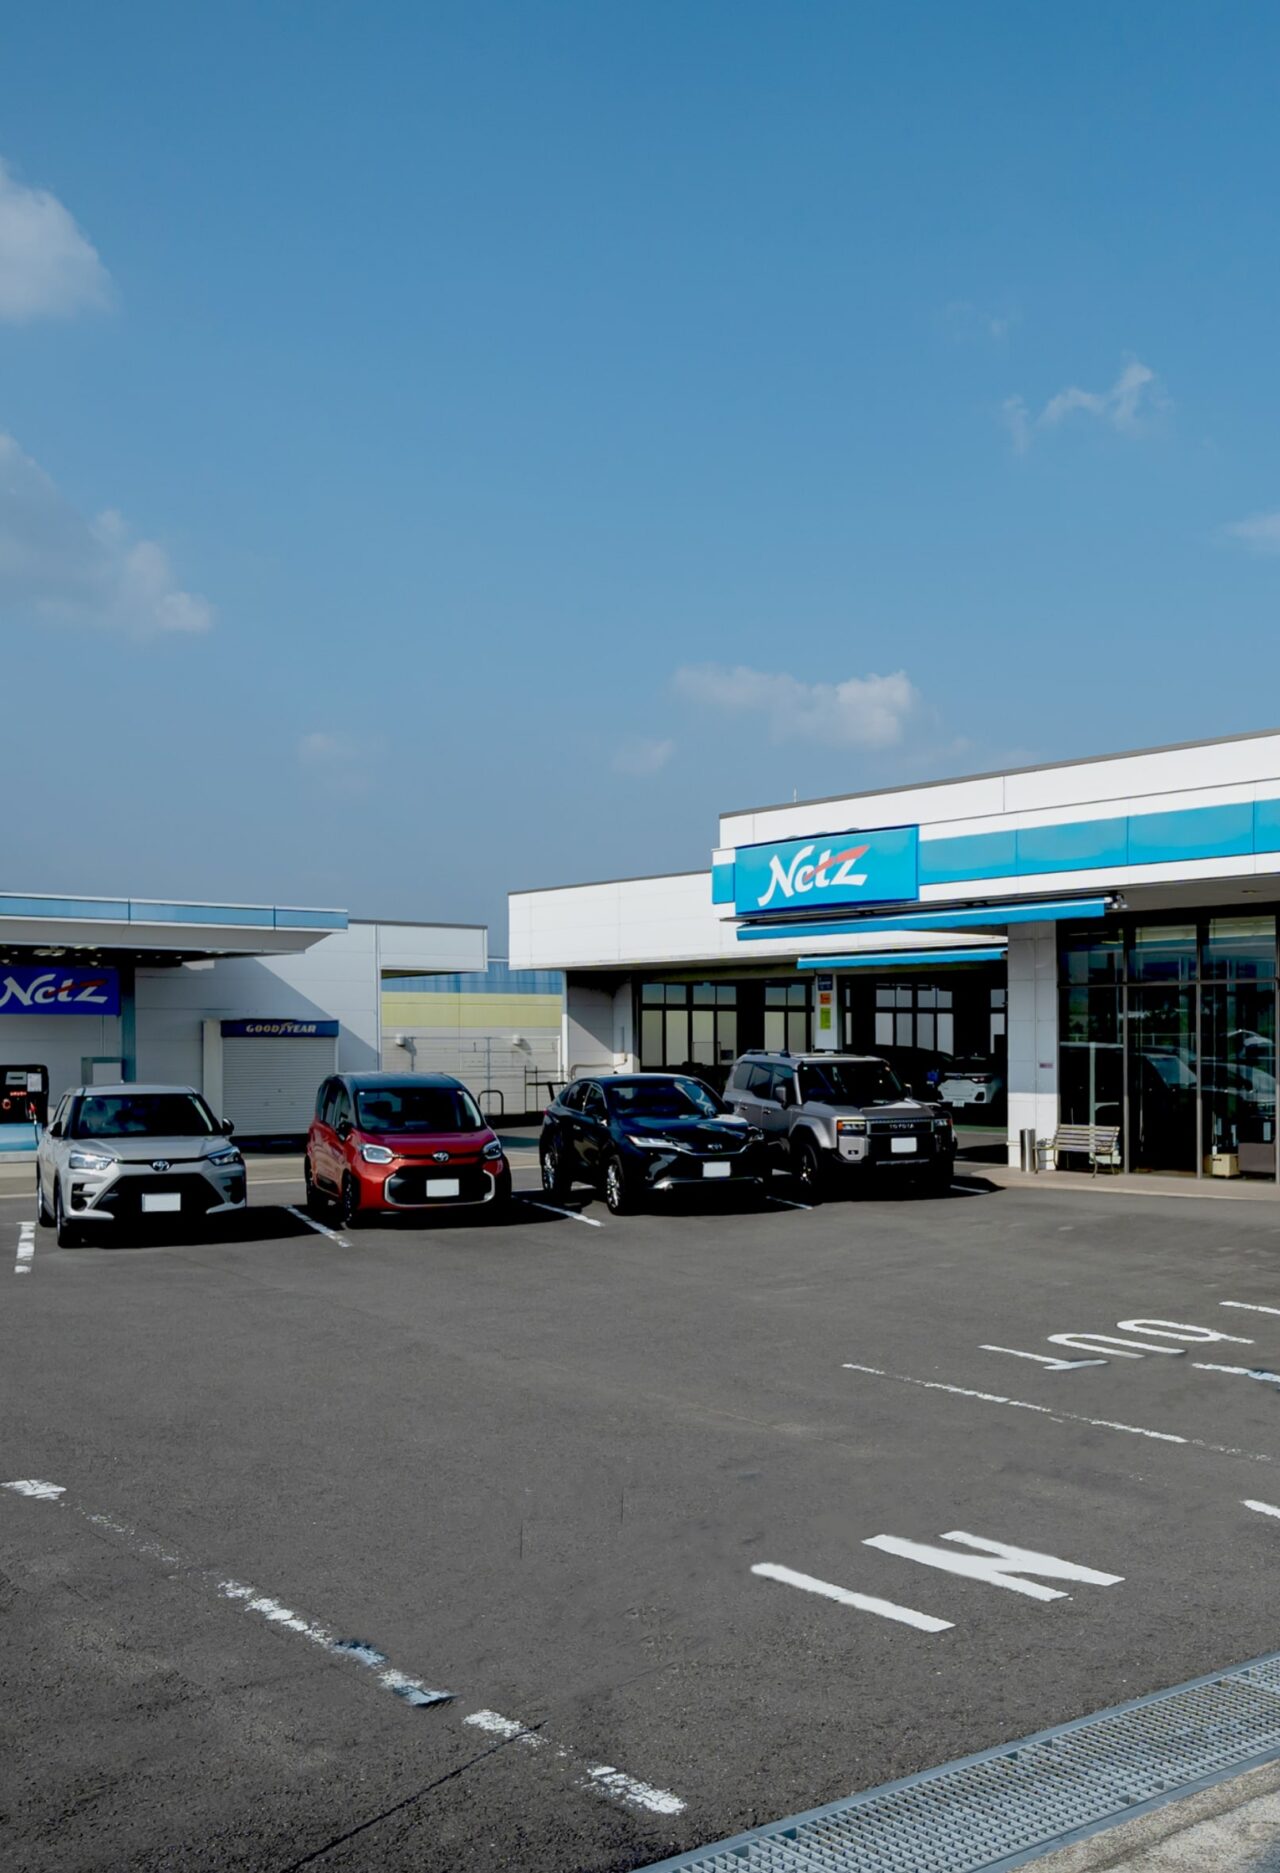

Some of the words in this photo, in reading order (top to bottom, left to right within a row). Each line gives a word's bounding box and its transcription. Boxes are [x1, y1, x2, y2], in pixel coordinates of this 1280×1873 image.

[757, 845, 870, 907] Netz
[246, 1023, 317, 1034] GOODYEAR
[750, 1530, 1126, 1633] IN
